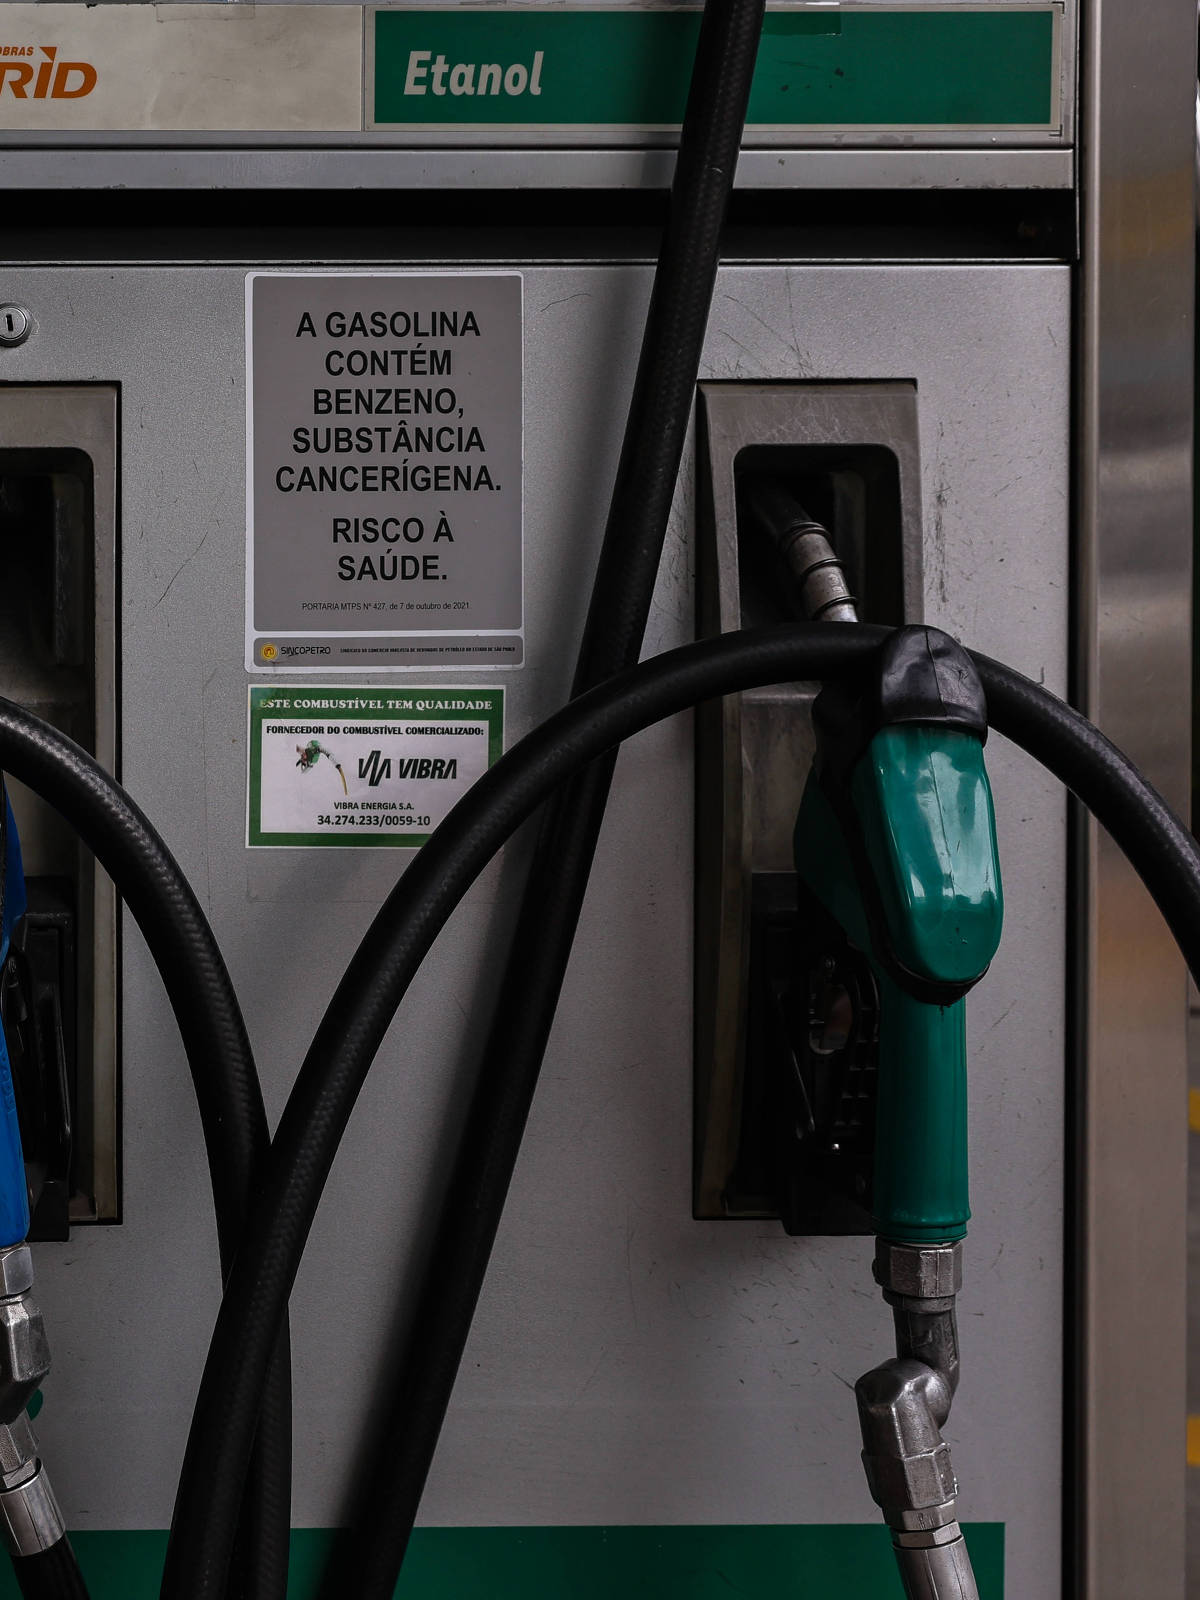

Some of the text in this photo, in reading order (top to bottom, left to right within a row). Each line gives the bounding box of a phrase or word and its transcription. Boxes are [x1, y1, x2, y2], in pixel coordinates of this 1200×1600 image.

[403, 50, 544, 97] Etanol
[295, 311, 481, 338] A GASOLINA
[325, 343, 452, 376] CONTÉM
[313, 388, 464, 418] BENZENO,
[292, 420, 486, 454] SUBSTÂNCIA
[275, 459, 502, 492] CANCERÍGENA.
[333, 511, 455, 543] RISCO À
[337, 549, 447, 581] SAÚDE.
[302, 602, 340, 610] PORTARIA
[340, 602, 362, 610] MTPS
[389, 602, 398, 610] de
[399, 602, 404, 610] 7
[406, 602, 414, 610] de
[415, 602, 441, 610] outubro
[443, 602, 451, 610] de
[280, 646, 331, 657] SINCOPETRO
[293, 697, 384, 709] COMBUSTÍVEL
[386, 699, 413, 710] TEM
[416, 700, 493, 711] QUALIDADE
[266, 724, 484, 736] FORNECEDOR DO COMBUSTÍVEL COMERCIALIZADO:
[399, 758, 457, 780] VIBRA
[334, 802, 415, 810] VIBRA ENERGIA S.A.
[317, 814, 431, 827] 34.274.233/0059-10
